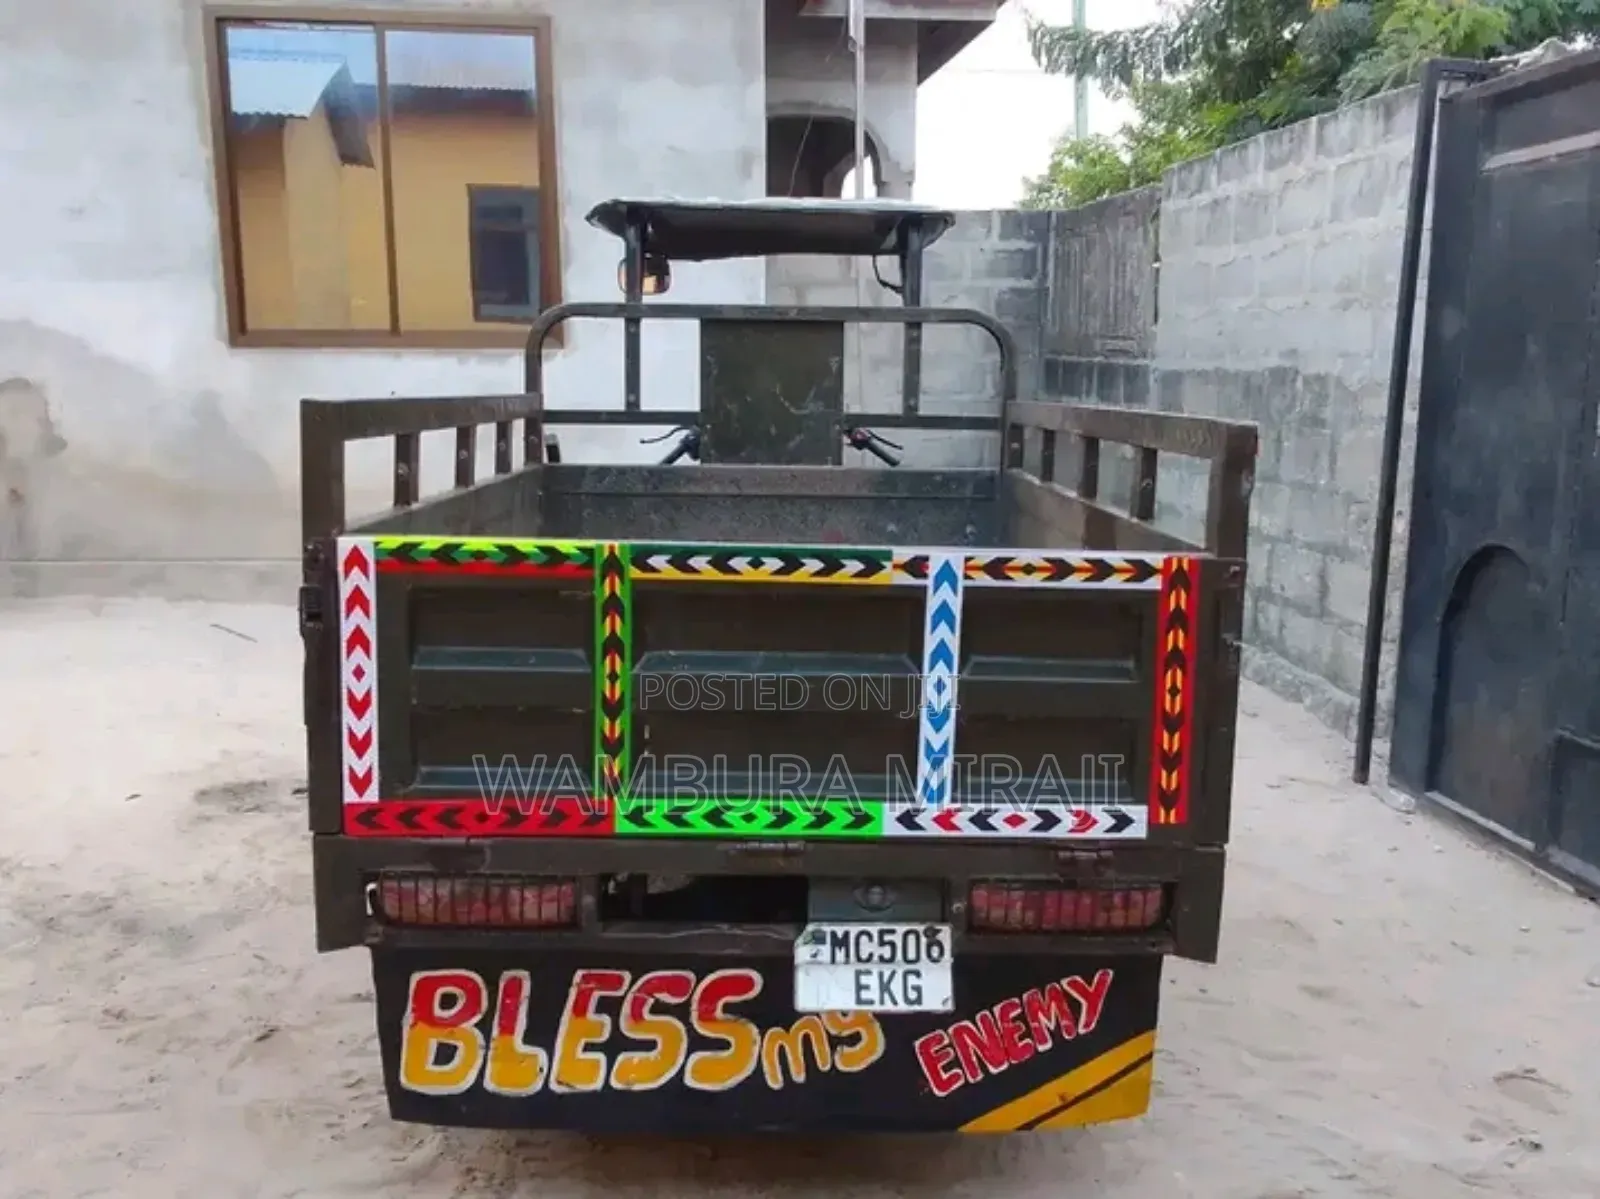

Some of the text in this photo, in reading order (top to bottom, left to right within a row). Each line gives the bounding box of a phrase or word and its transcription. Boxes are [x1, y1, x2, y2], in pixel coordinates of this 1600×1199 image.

[854, 969, 923, 1006] EKG
[400, 968, 762, 1096] BLESS
[914, 969, 1113, 1097] ENEMY
